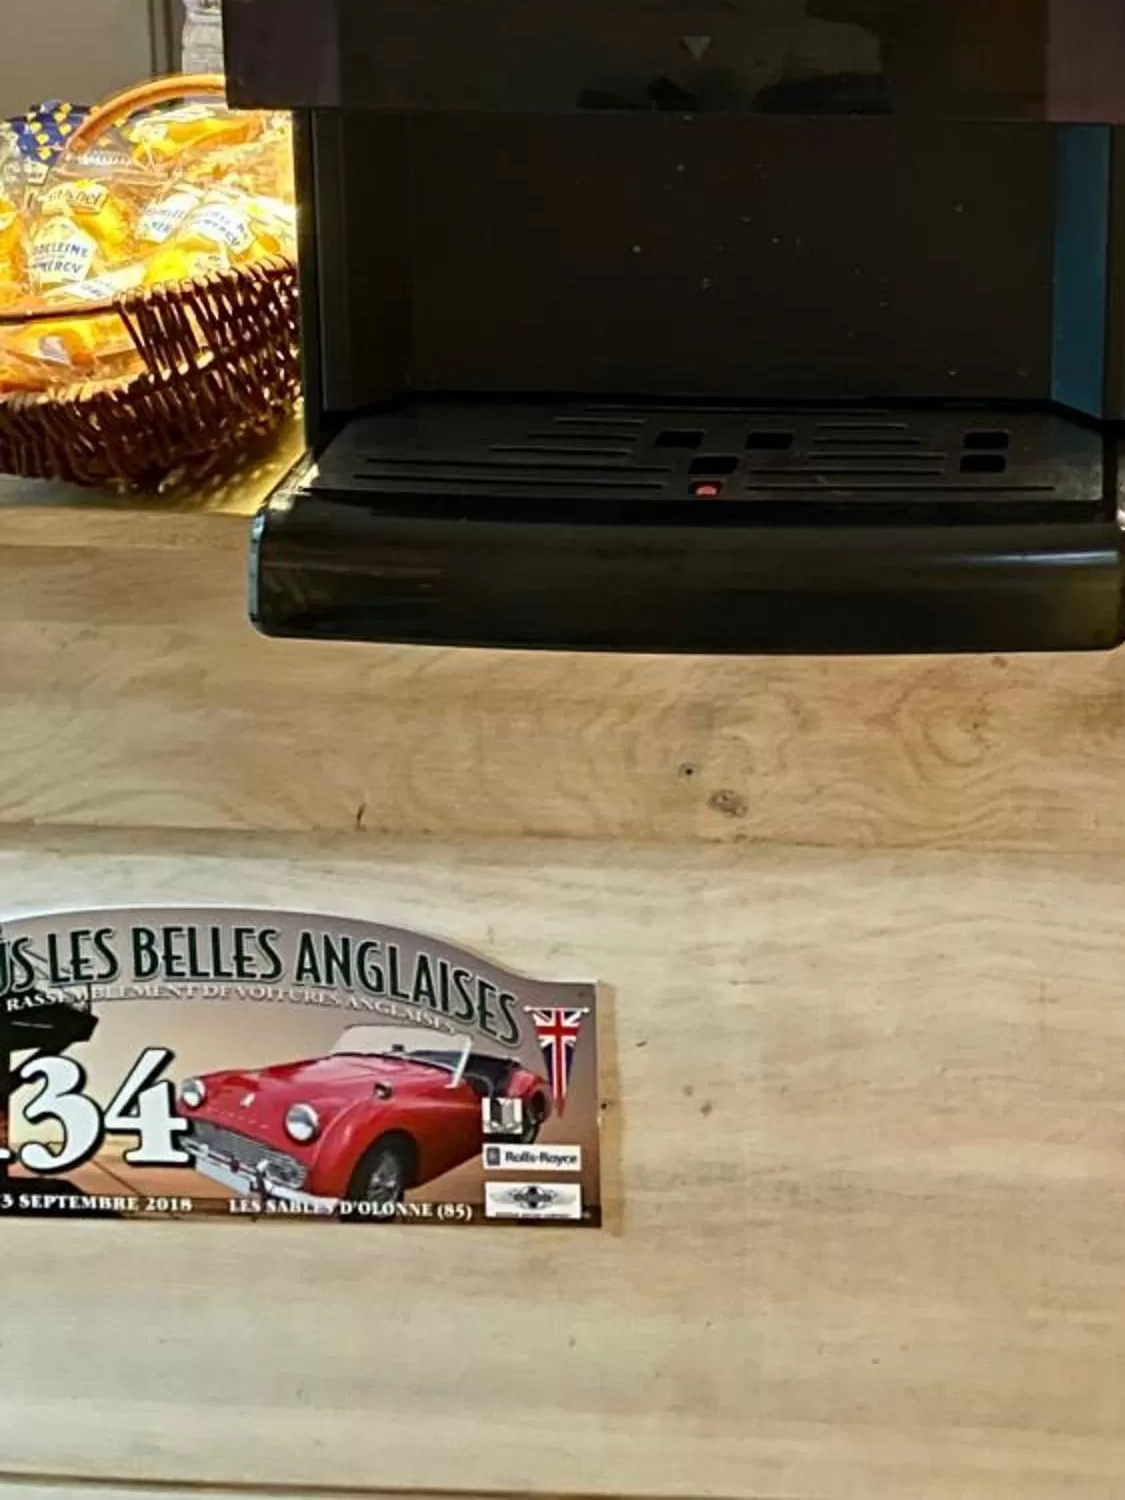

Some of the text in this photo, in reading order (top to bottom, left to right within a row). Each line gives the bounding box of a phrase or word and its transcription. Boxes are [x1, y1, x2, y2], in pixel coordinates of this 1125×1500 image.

[48, 928, 119, 983] LES
[132, 927, 283, 980] BELLES
[295, 931, 521, 1046] ANGLAISES
[6, 984, 455, 1036] RASSEMBLEMENT DE VOITURES ANGLAISES
[0, 1049, 189, 1170] 34
[505, 1151, 578, 1166] Rolls-Royce
[18, 1193, 140, 1211] SEPTEMBRE
[145, 1196, 193, 1212] 2018
[229, 1199, 473, 1221] LES SABLES D'OLONNE (85)
